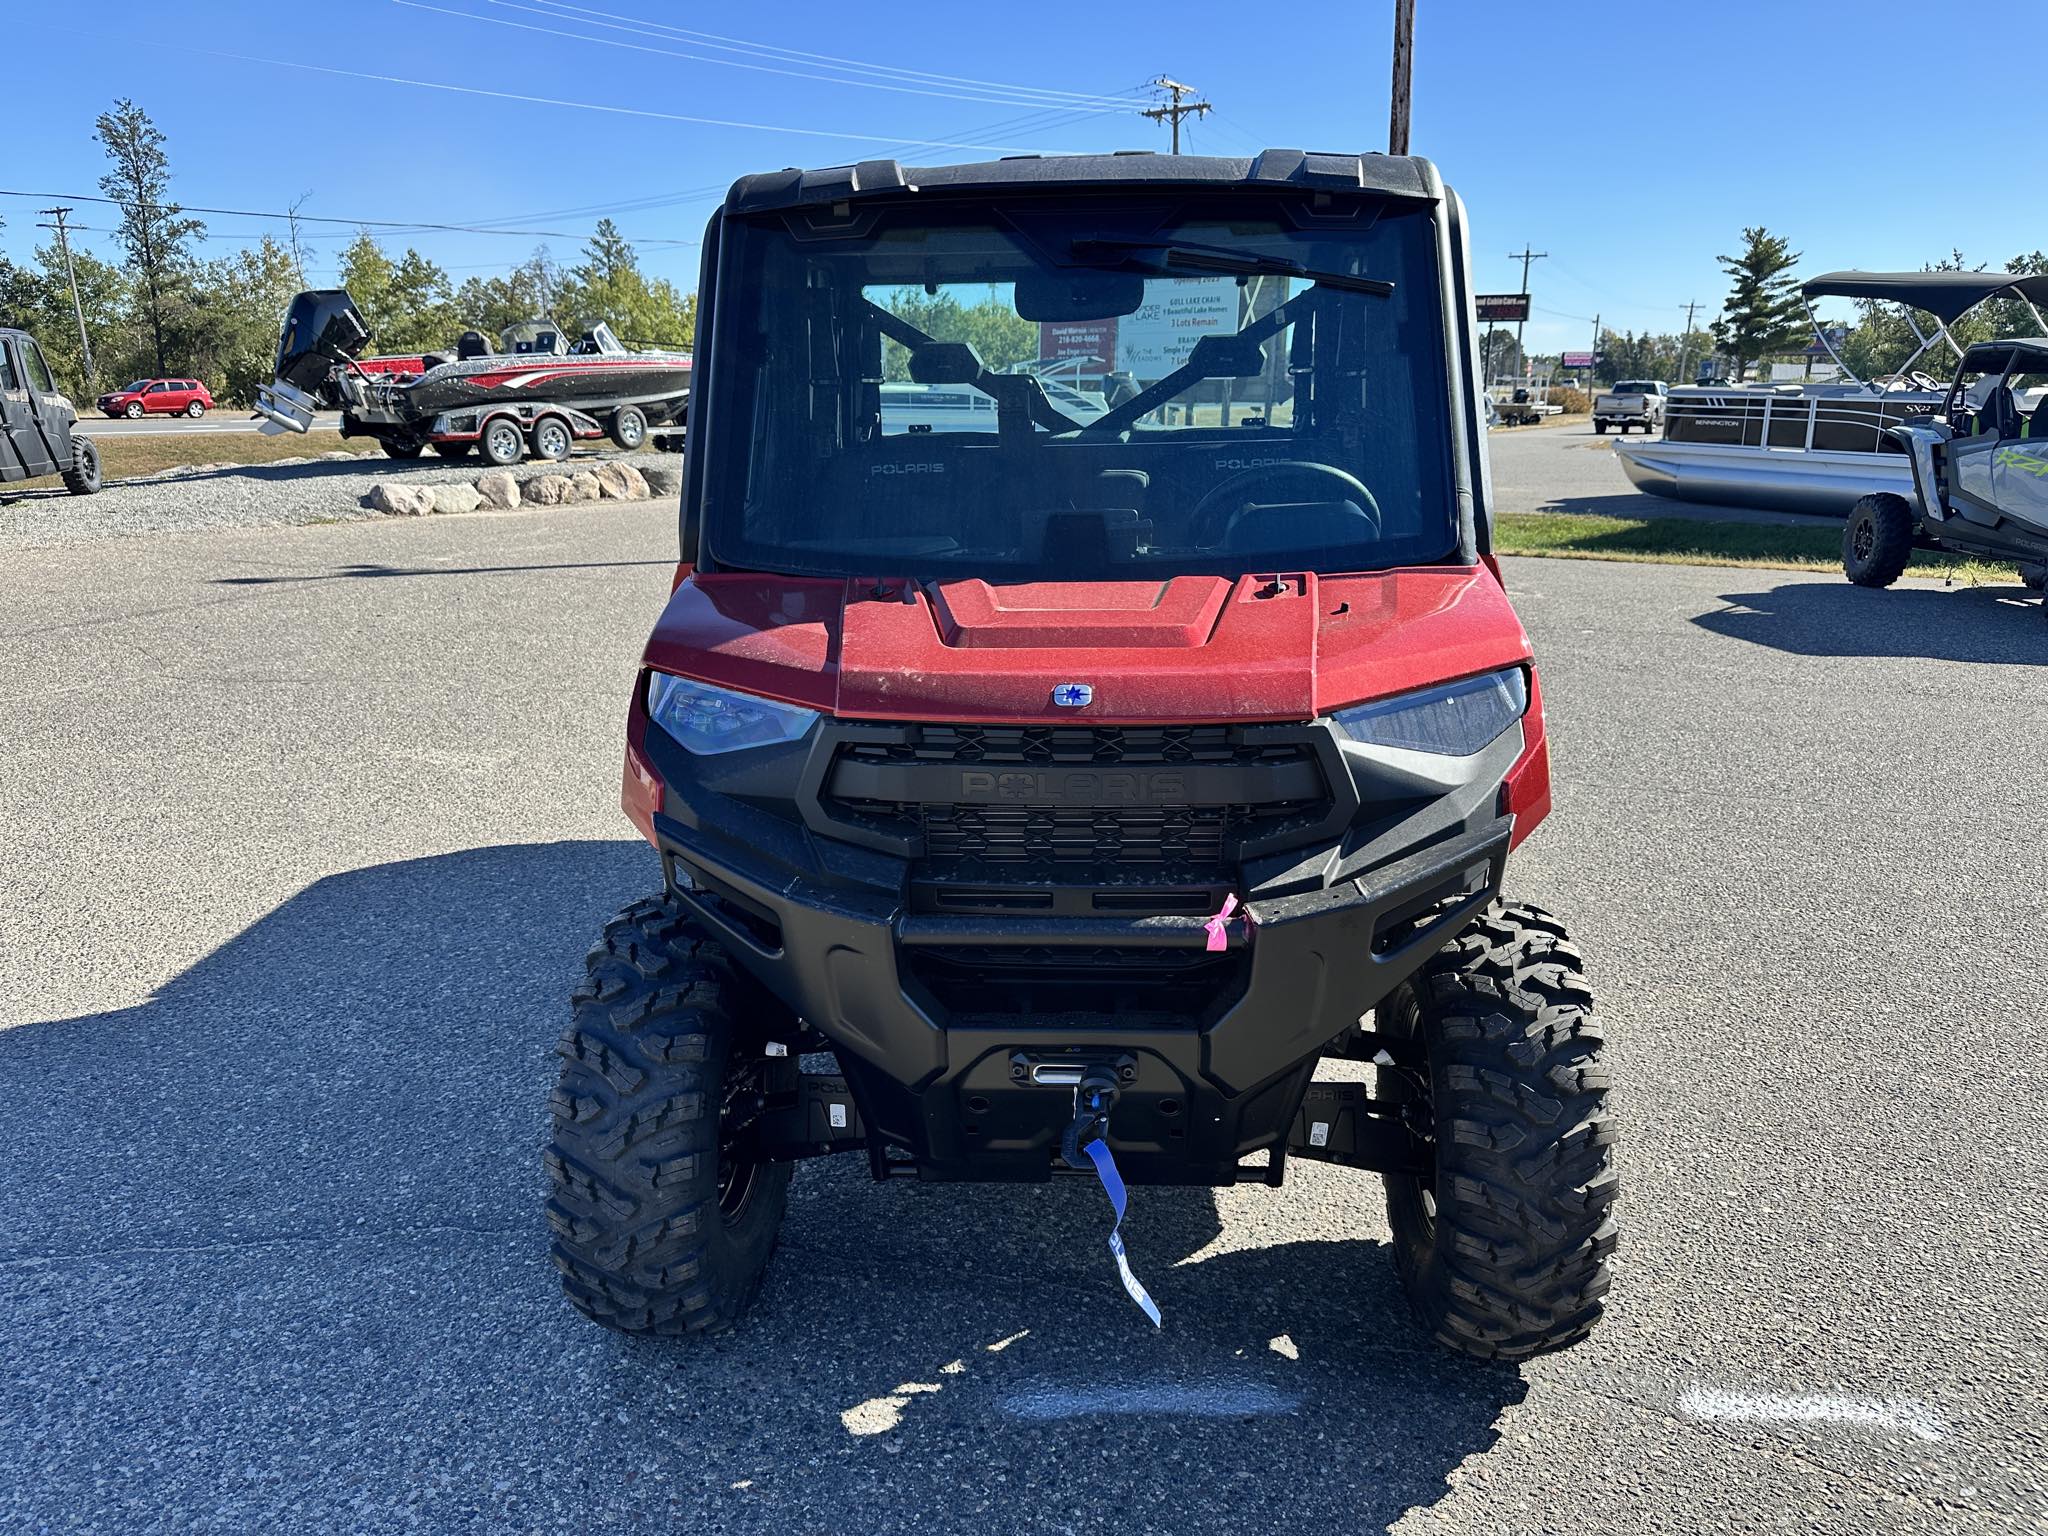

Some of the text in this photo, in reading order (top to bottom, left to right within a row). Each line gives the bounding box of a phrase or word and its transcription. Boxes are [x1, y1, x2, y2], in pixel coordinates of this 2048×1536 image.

[1185, 297, 1201, 305] LAKE
[1202, 296, 1220, 304] CHAIN
[1135, 311, 1161, 321] LAKE
[1176, 318, 1191, 328] Lots
[1192, 316, 1218, 327] Remain
[1695, 419, 1739, 427] BENNINGTON
[871, 462, 945, 476] POLARIS
[961, 770, 1187, 801] POLARIS
